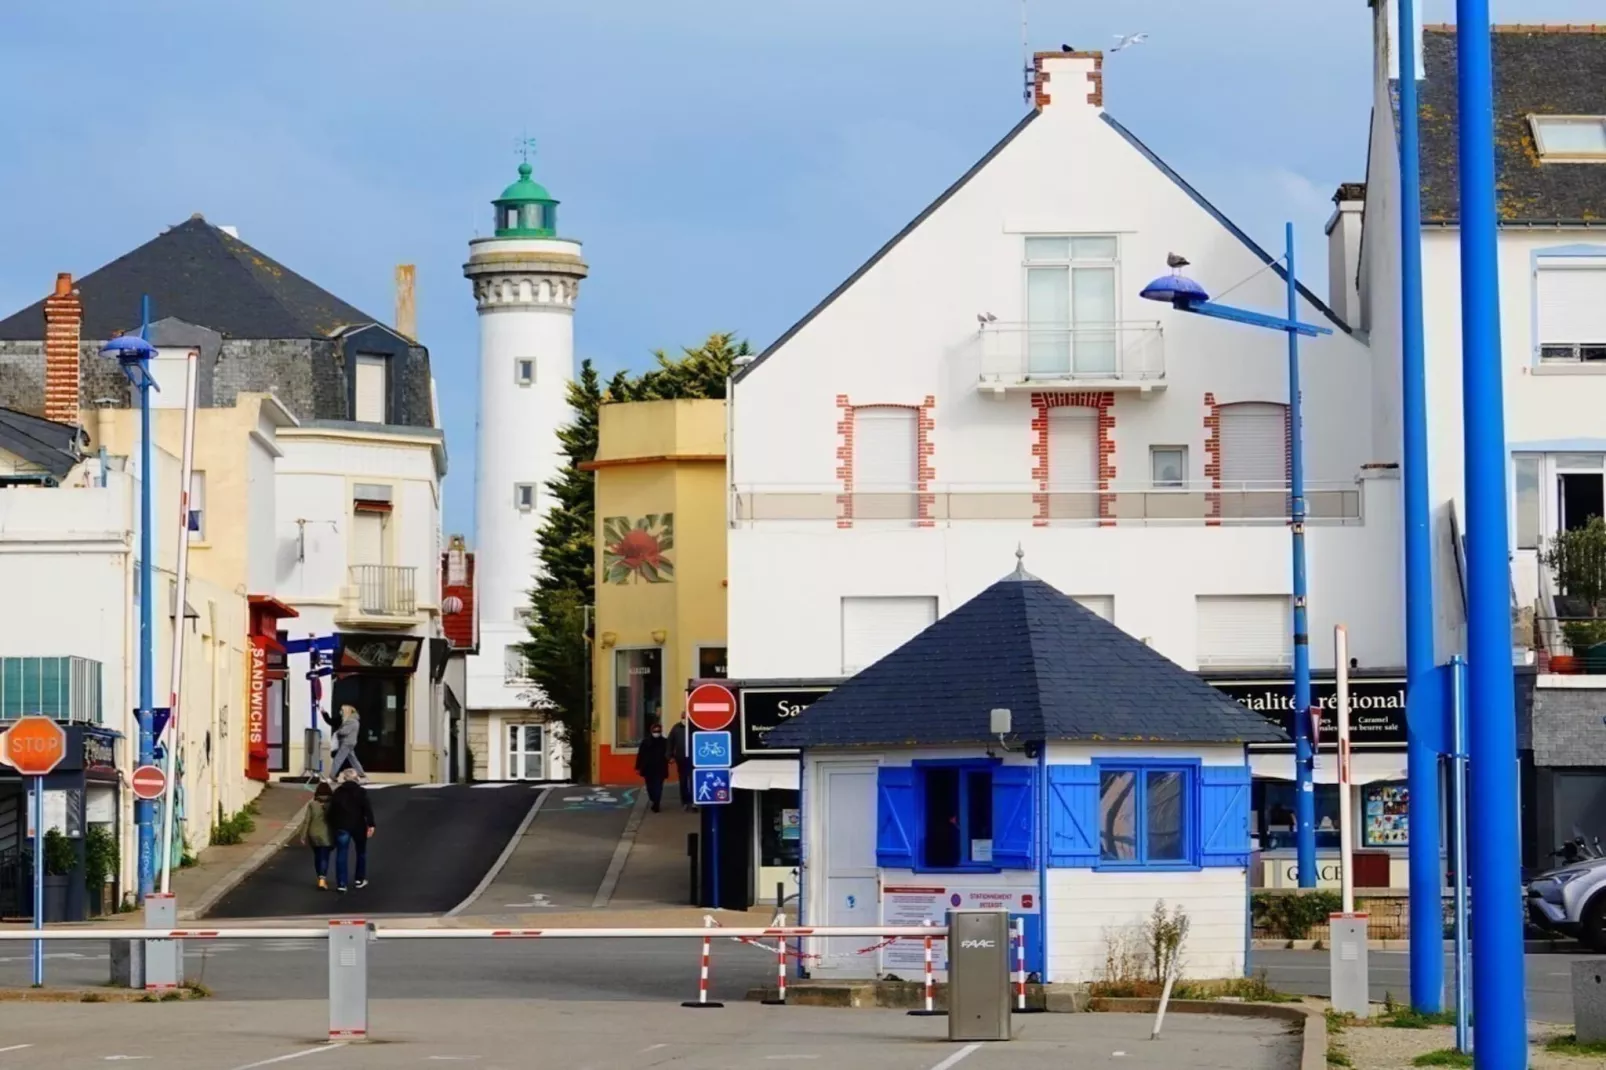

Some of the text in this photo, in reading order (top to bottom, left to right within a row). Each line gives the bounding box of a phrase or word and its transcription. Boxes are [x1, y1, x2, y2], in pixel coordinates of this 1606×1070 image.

[250, 648, 265, 743] SANDWICHS
[1358, 715, 1389, 724] Caramel
[12, 737, 58, 753] STOP
[1287, 866, 1342, 881] GCE
[961, 939, 996, 948] FAAC
